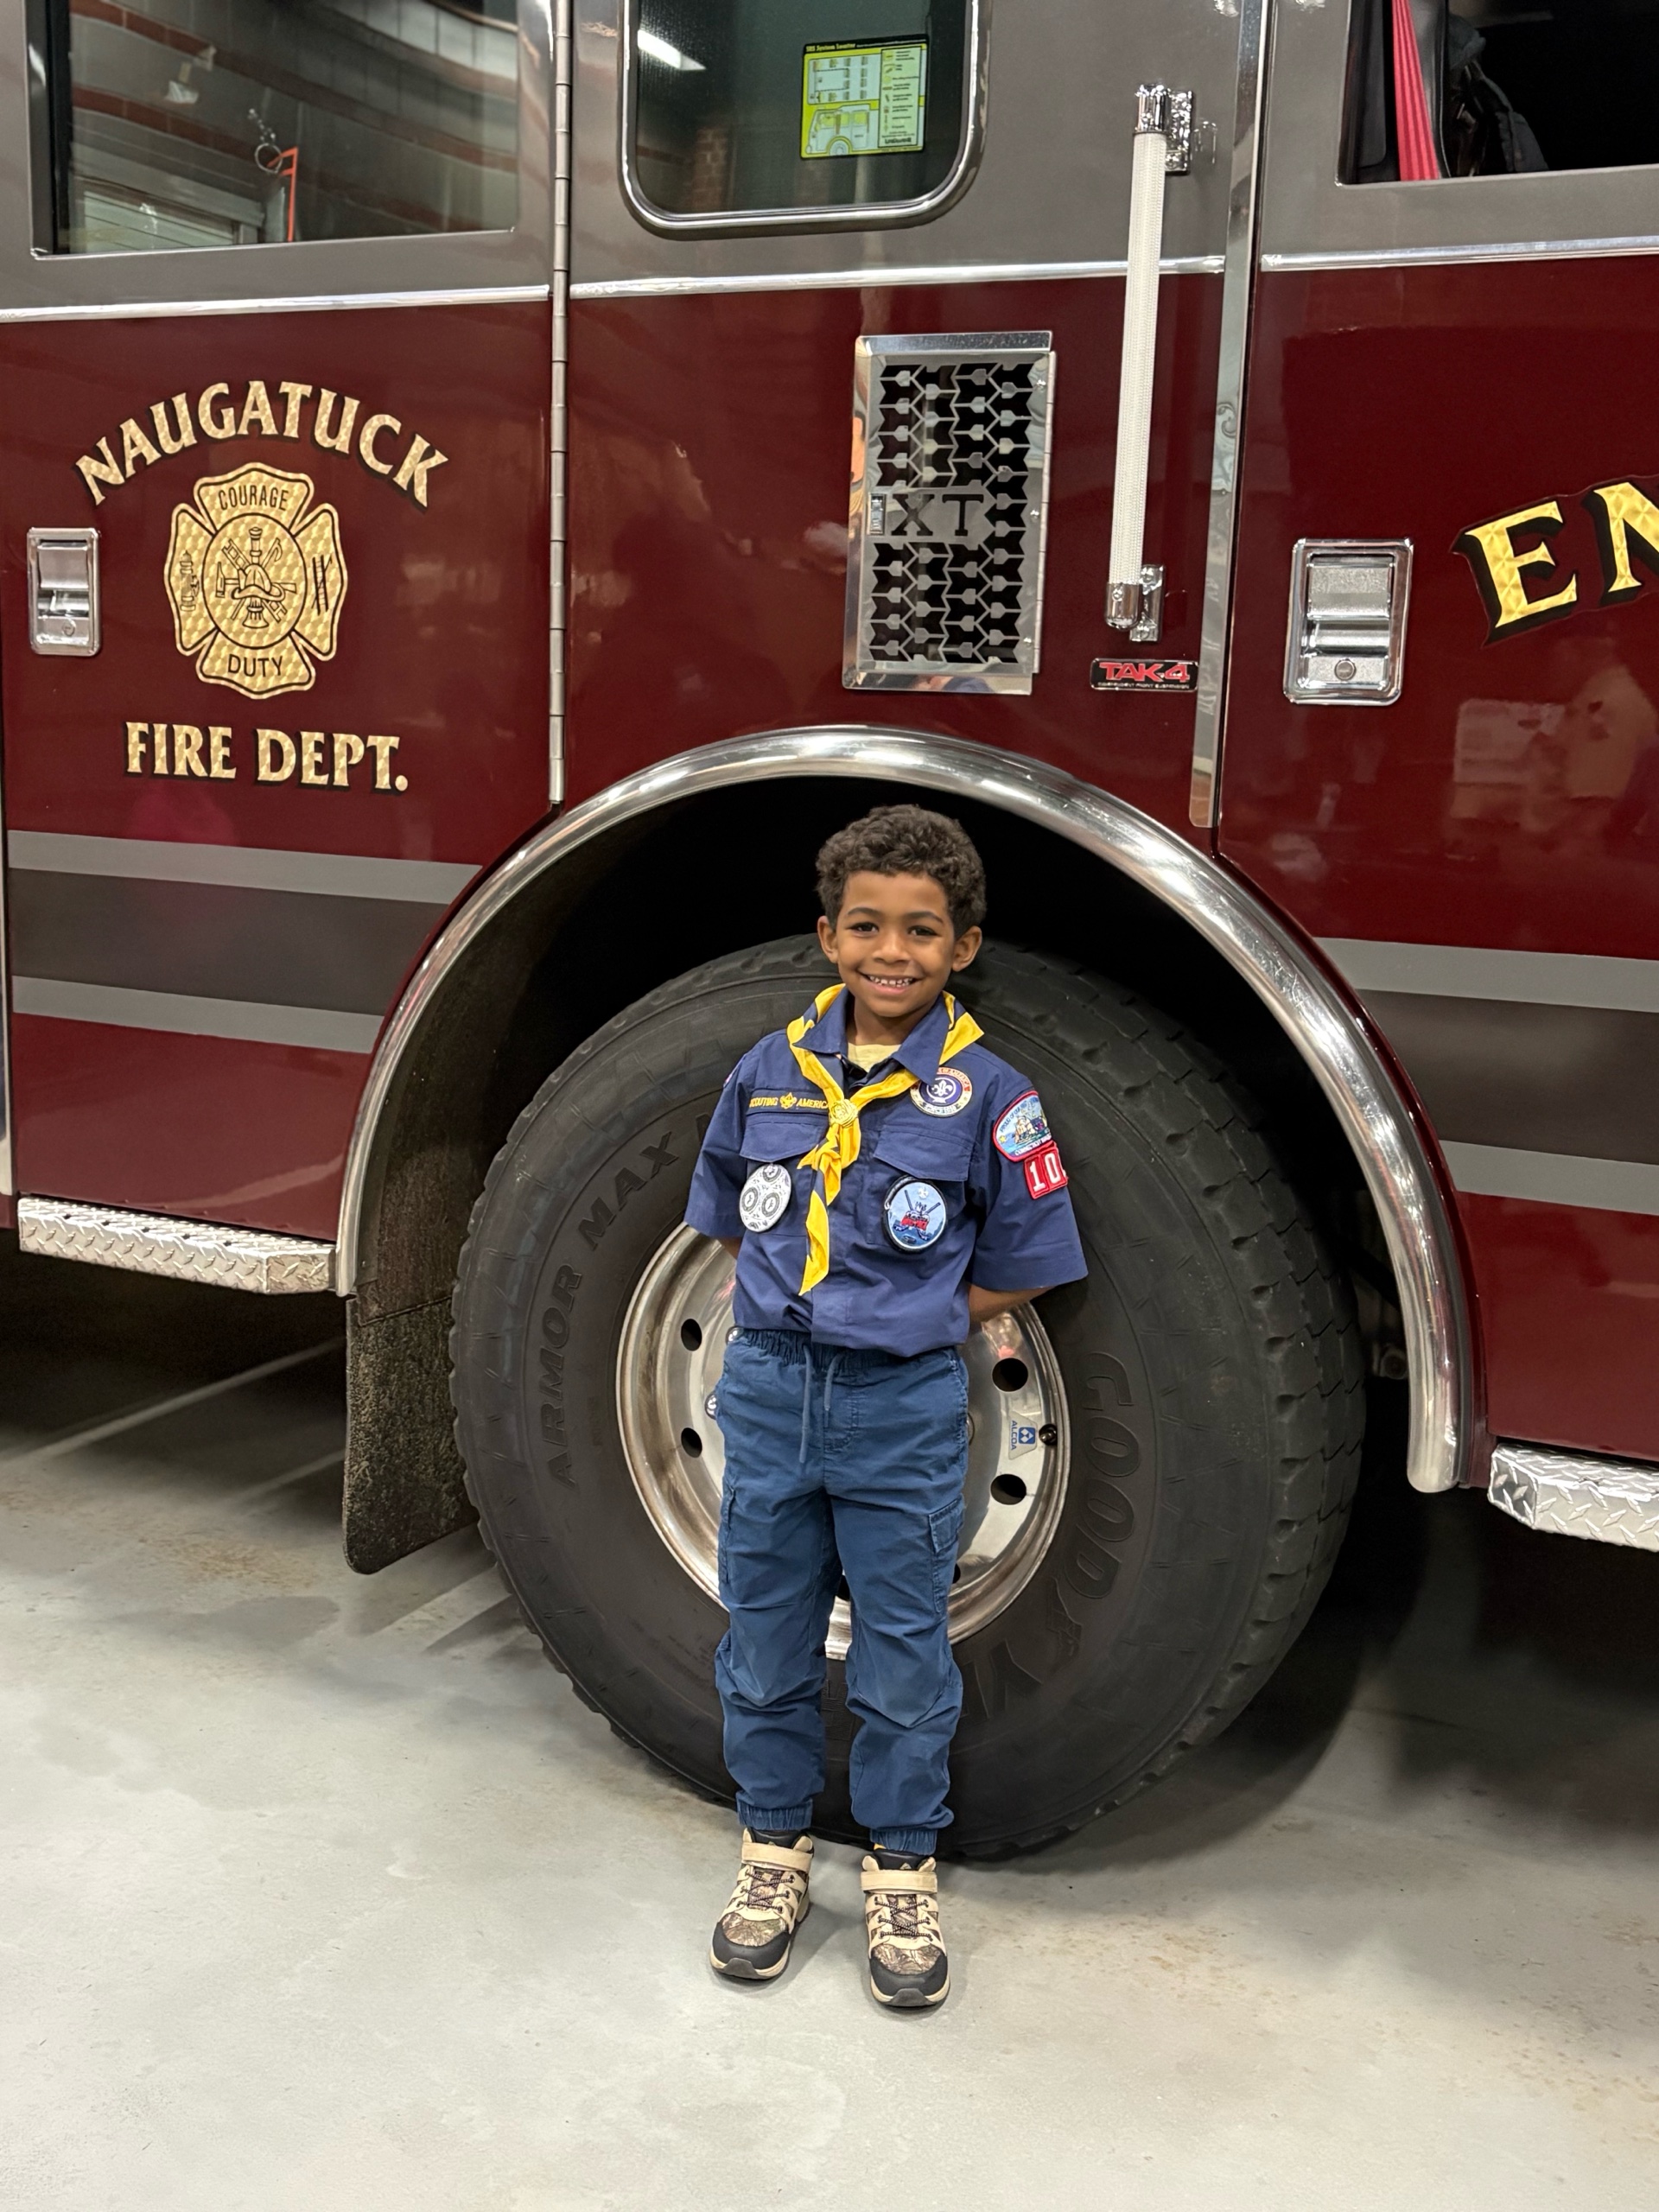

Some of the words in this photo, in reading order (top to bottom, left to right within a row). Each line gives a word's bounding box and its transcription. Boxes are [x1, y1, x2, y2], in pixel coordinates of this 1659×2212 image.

[75, 380, 449, 508] NAUGATUCK
[218, 484, 289, 511] COURAGE
[890, 493, 985, 537] XT
[226, 653, 284, 678] DUTY
[1099, 662, 1190, 683] TAK-4
[125, 721, 237, 779] FIRE
[255, 728, 410, 791] DEPT.
[796, 1097, 829, 1109] AMERIC
[537, 1262, 583, 1491] ARMOR
[576, 1130, 680, 1252] MAX
